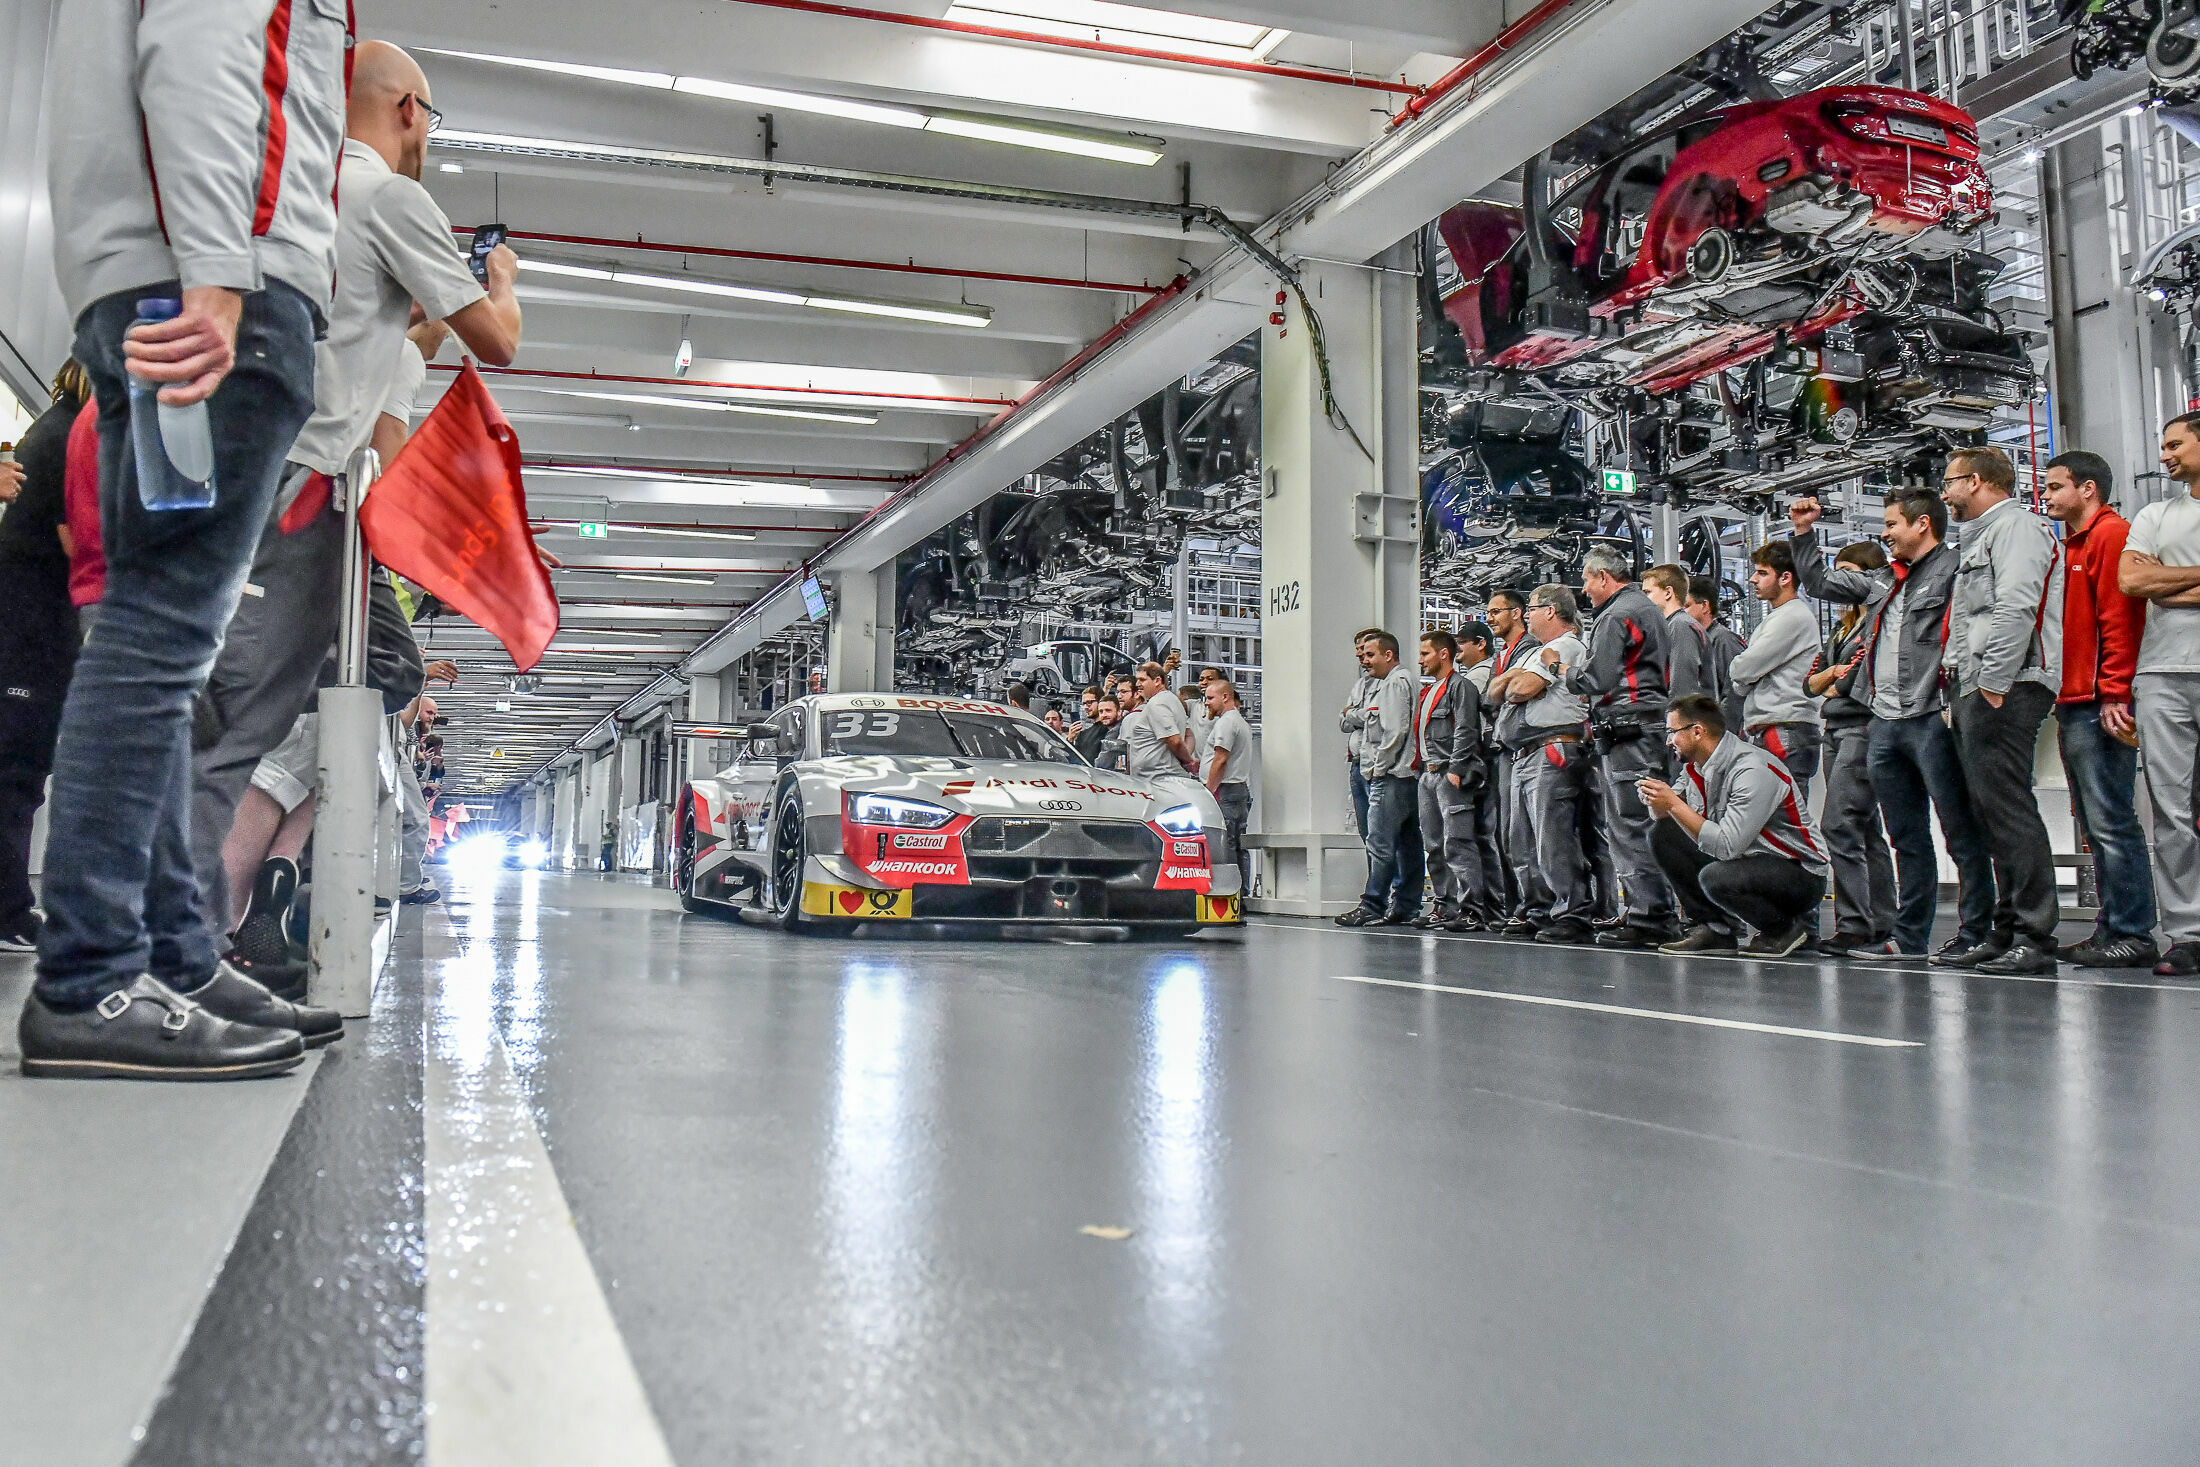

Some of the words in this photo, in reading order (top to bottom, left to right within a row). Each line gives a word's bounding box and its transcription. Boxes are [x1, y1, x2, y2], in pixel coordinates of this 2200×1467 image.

[1270, 580, 1300, 617] H32
[896, 698, 1009, 715] BOSCH
[830, 712, 901, 739] 33
[1064, 778, 1156, 801] Sport
[906, 835, 943, 848] Castrol
